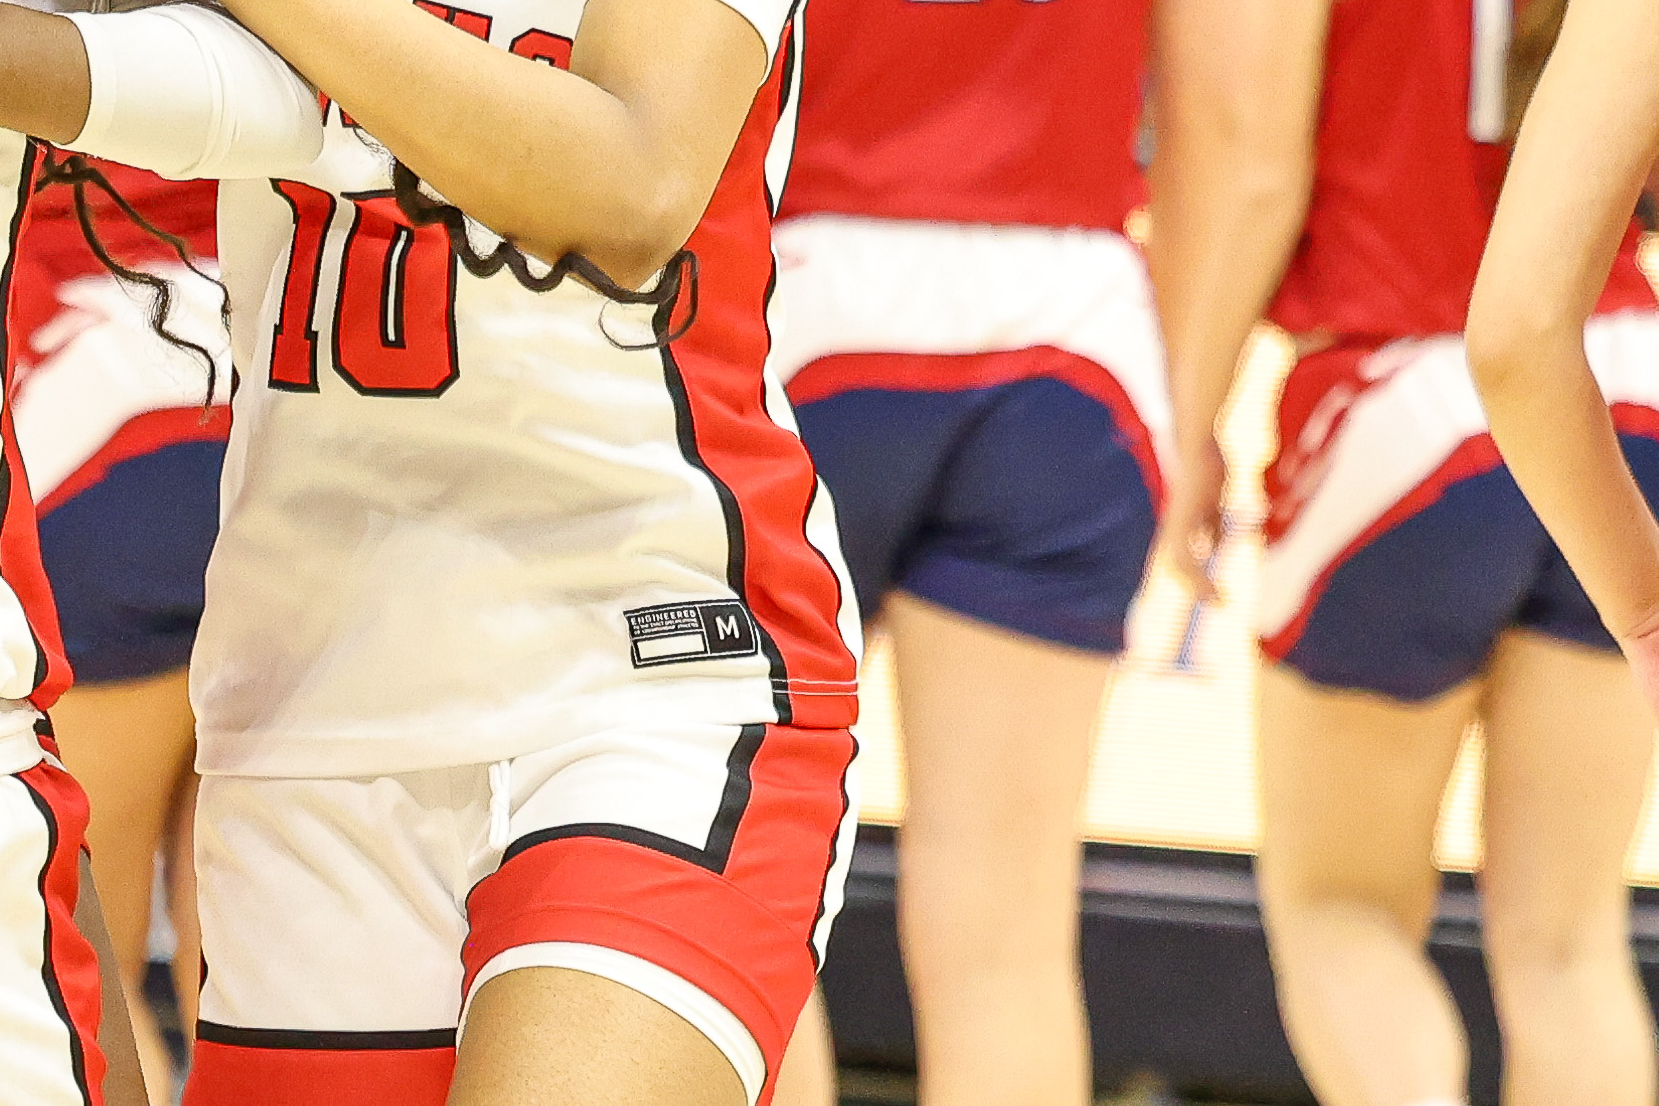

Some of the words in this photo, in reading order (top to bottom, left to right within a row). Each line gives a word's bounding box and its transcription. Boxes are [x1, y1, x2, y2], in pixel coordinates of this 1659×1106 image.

[268, 177, 461, 399] 10
[630, 609, 697, 627] ENGINEERED
[715, 614, 741, 641] M
